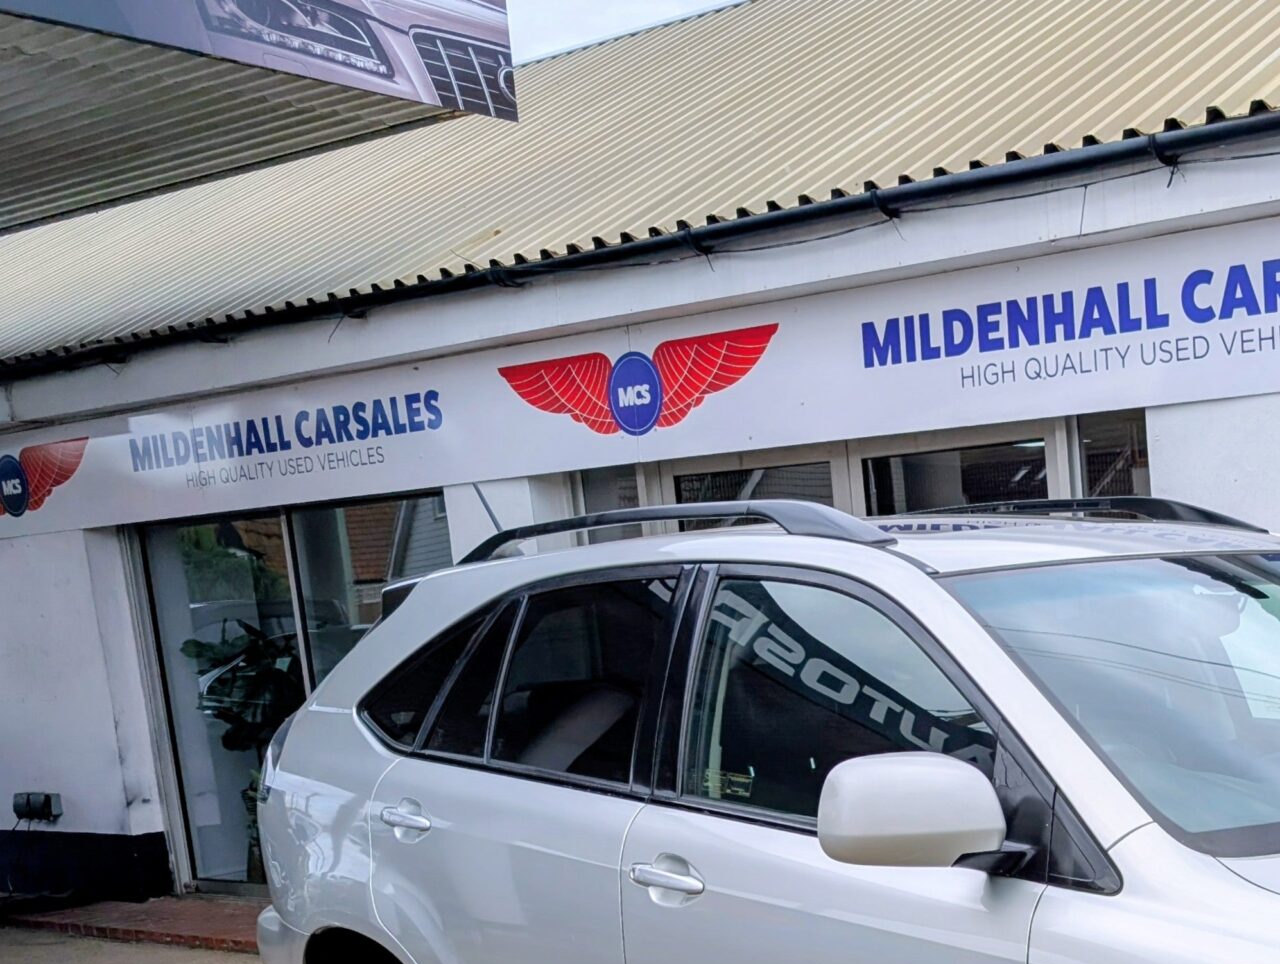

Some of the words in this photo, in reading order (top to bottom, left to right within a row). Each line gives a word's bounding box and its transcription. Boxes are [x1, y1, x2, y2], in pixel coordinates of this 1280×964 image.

[861, 277, 1170, 368] MILDENHALL
[960, 360, 1016, 388] HIGH
[1024, 345, 1131, 381] QUALITY
[1139, 335, 1210, 366] USED
[617, 383, 651, 408] MCS
[128, 414, 292, 473] MILDENHALL
[294, 389, 443, 448] CARSALES
[1, 478, 23, 496] MCS
[186, 470, 217, 489] HIGH
[219, 461, 274, 483] QUALITY
[278, 455, 314, 476] USED
[316, 446, 385, 471] VEHICLES
